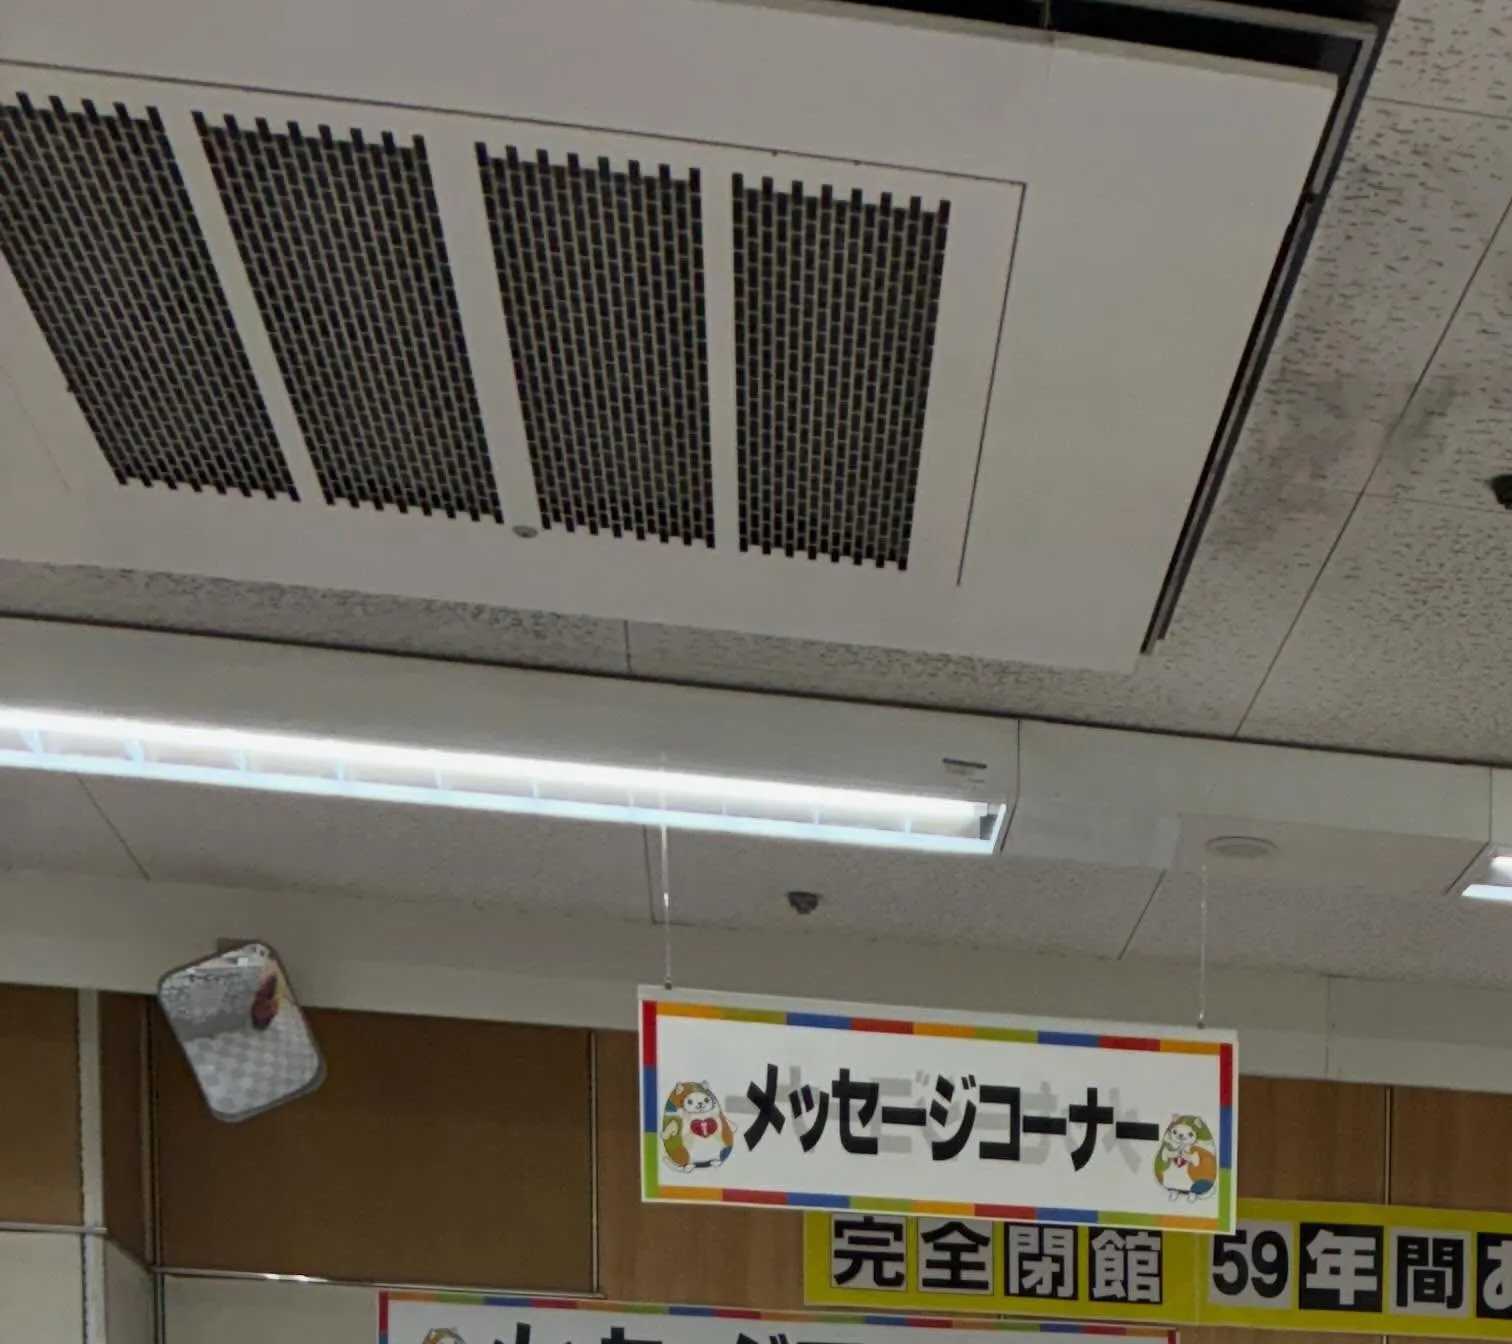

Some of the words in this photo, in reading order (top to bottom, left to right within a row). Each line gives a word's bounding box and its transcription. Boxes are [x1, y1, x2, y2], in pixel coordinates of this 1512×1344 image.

[744, 1064, 1158, 1170] メッセージコーナー
[833, 1216, 1161, 1302] 完全閉館
